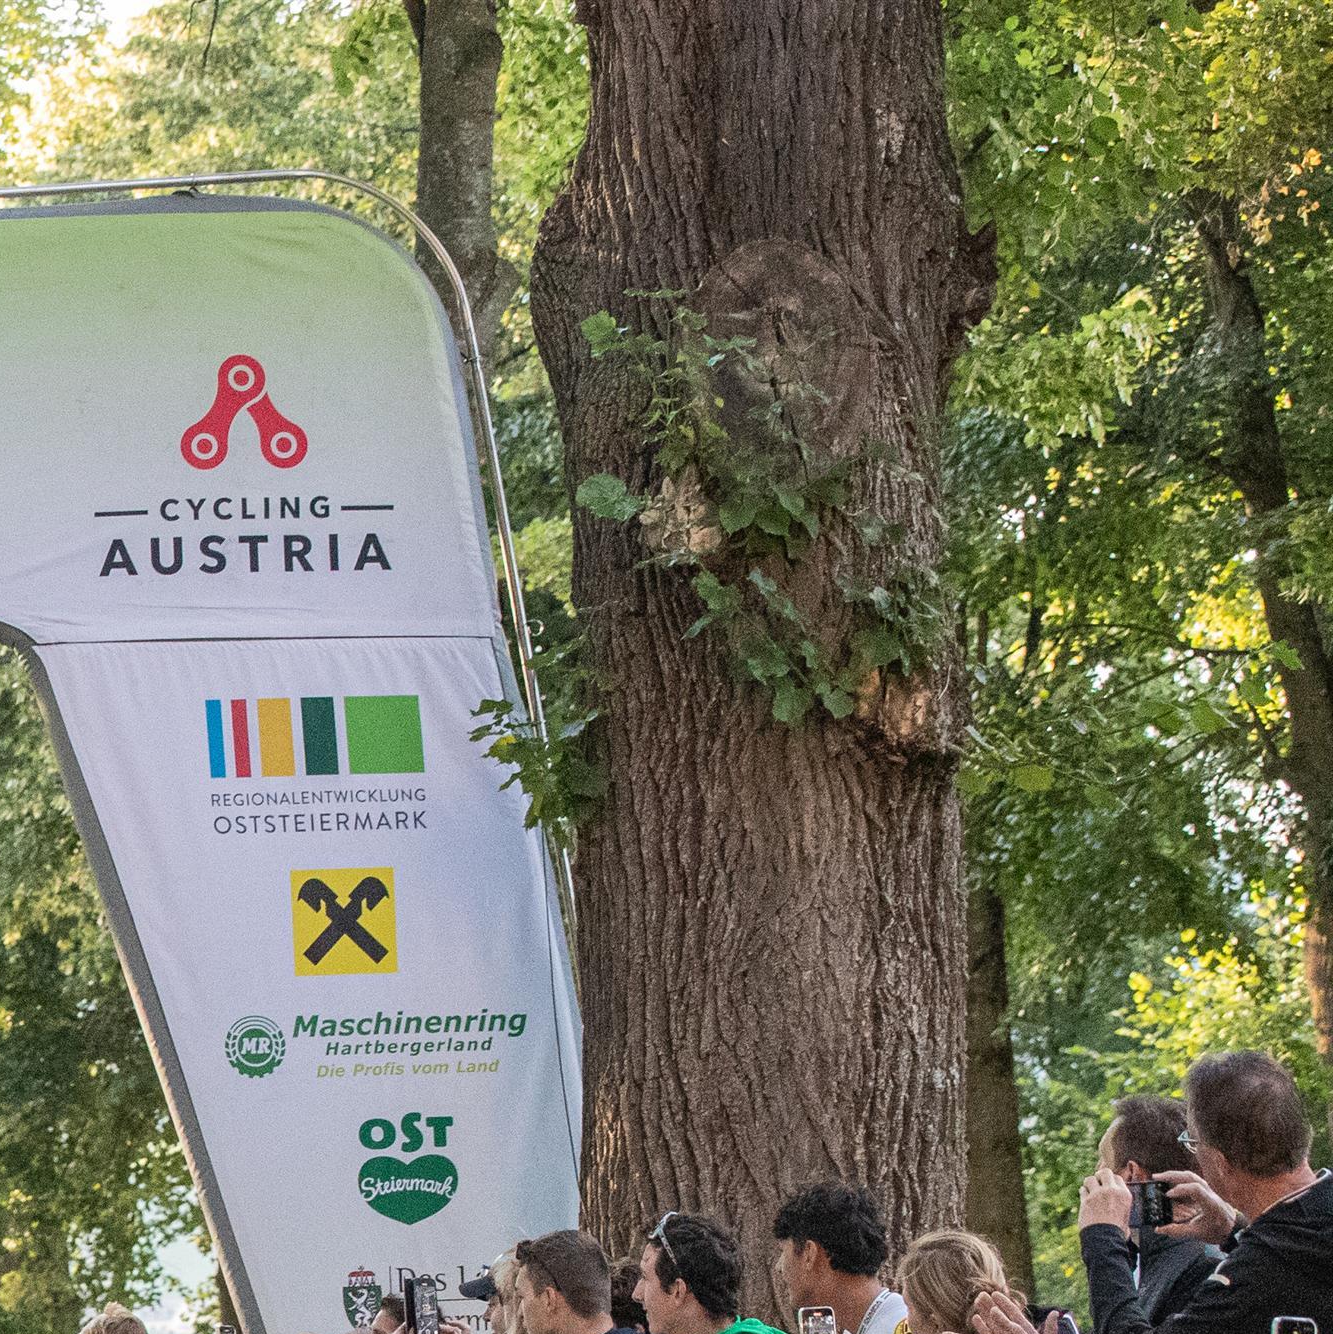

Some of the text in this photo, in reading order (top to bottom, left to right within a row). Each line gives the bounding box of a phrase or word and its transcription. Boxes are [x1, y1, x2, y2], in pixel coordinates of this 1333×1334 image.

[160, 495, 331, 522] CYCLING
[99, 533, 392, 577] AUSTRIA
[211, 787, 427, 808] REGIONALENTWICKLUNG
[213, 810, 428, 835] OSTSTEIERMARK
[293, 1008, 527, 1039] Maschinenring
[240, 1037, 272, 1056] MR
[325, 1036, 492, 1057] Hartbergerland
[316, 1059, 500, 1078] Die Profis vom Land
[358, 1112, 454, 1153] OST
[361, 1176, 454, 1201] Steiermark
[396, 1266, 447, 1292] Ds
